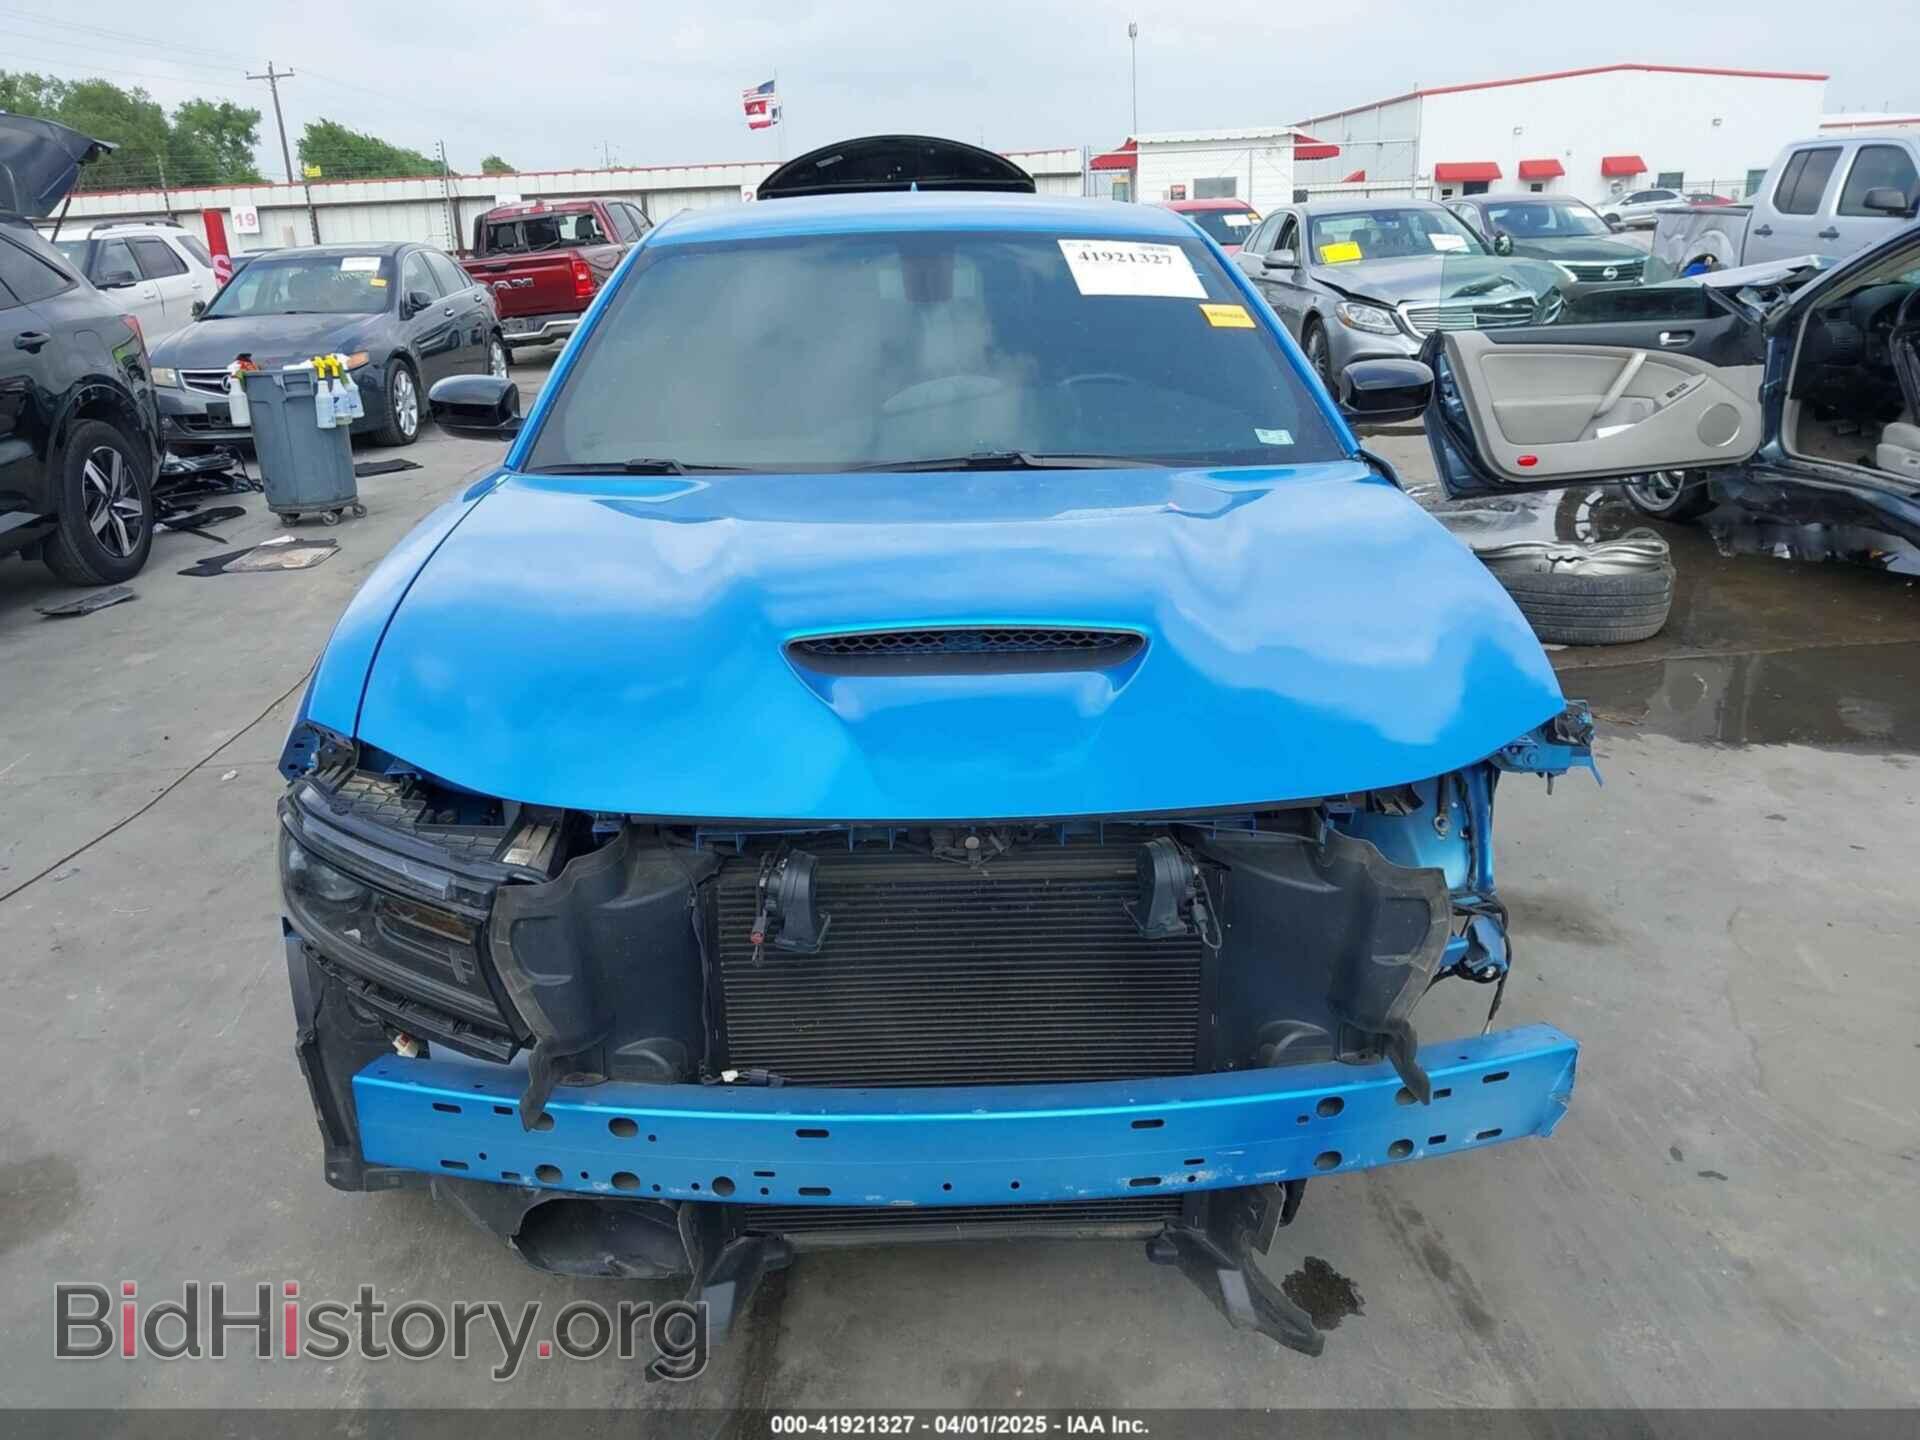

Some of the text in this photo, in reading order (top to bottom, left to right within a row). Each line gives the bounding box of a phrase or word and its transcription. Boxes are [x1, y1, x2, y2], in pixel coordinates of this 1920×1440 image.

[234, 212, 257, 227] 19
[1078, 251, 1172, 265] 41921327
[492, 277, 535, 290] AM
